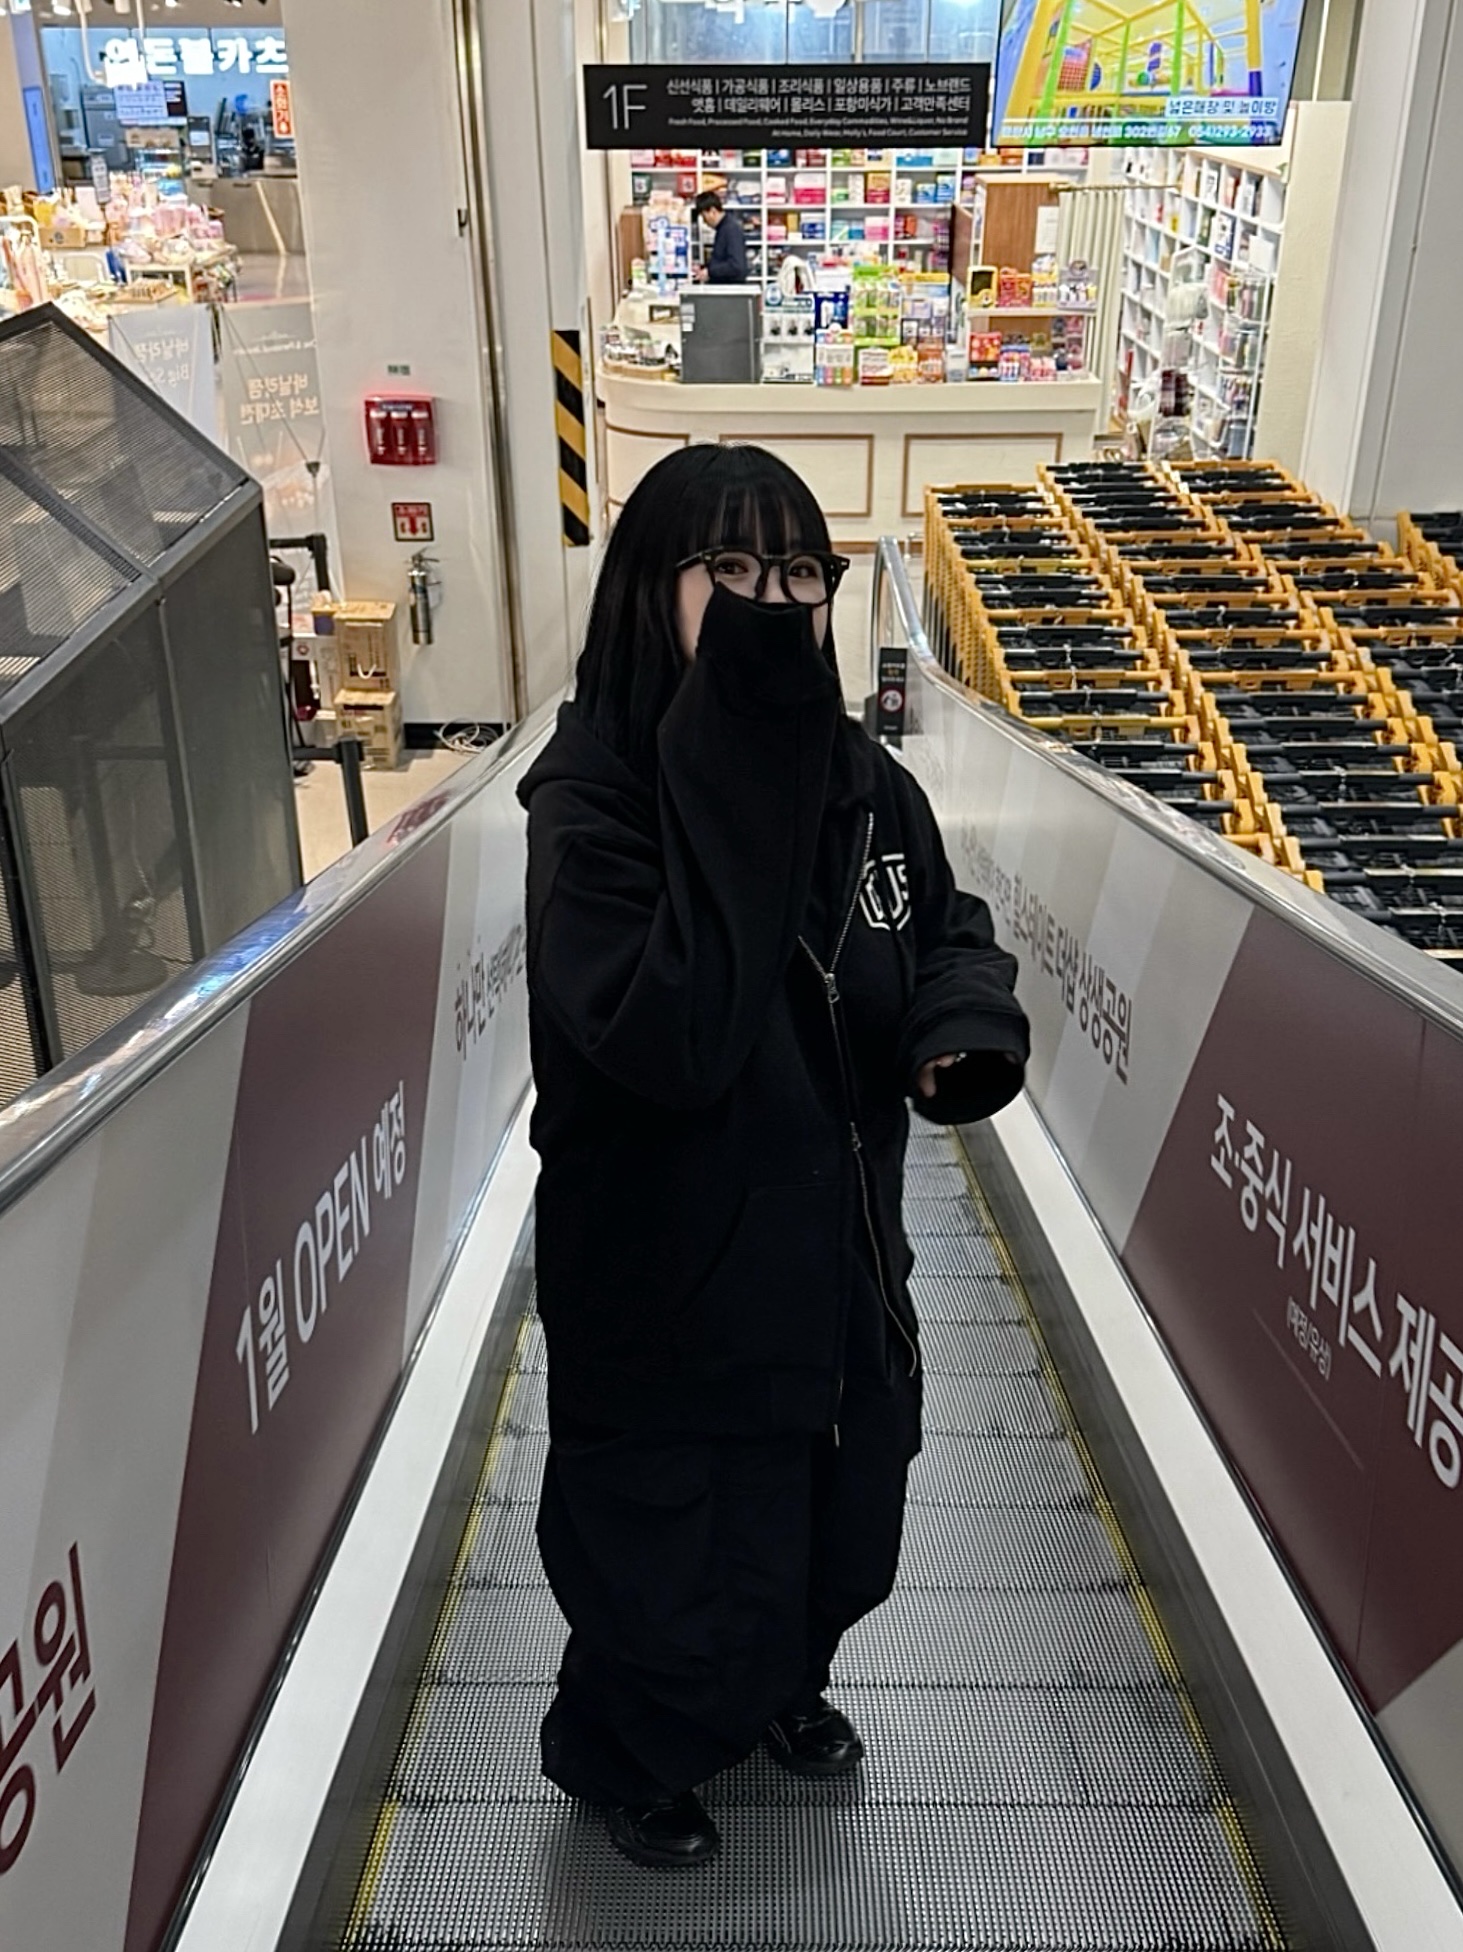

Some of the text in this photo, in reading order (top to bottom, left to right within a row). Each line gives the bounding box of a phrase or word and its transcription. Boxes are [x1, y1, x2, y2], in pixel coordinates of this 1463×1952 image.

[603, 84, 647, 130] 1F
[666, 78, 971, 94] 신선식품 가공식품 조리식품 일상용품 주류 노브랜드
[791, 97, 825, 112] 몰리스
[900, 97, 970, 112] 고객만족센터
[1078, 948, 1132, 1086] 상생공원
[236, 1080, 407, 1434] 1월 OPEN 예정
[1293, 1186, 1383, 1379] 서비스
[1388, 1292, 1463, 1490] 제공
